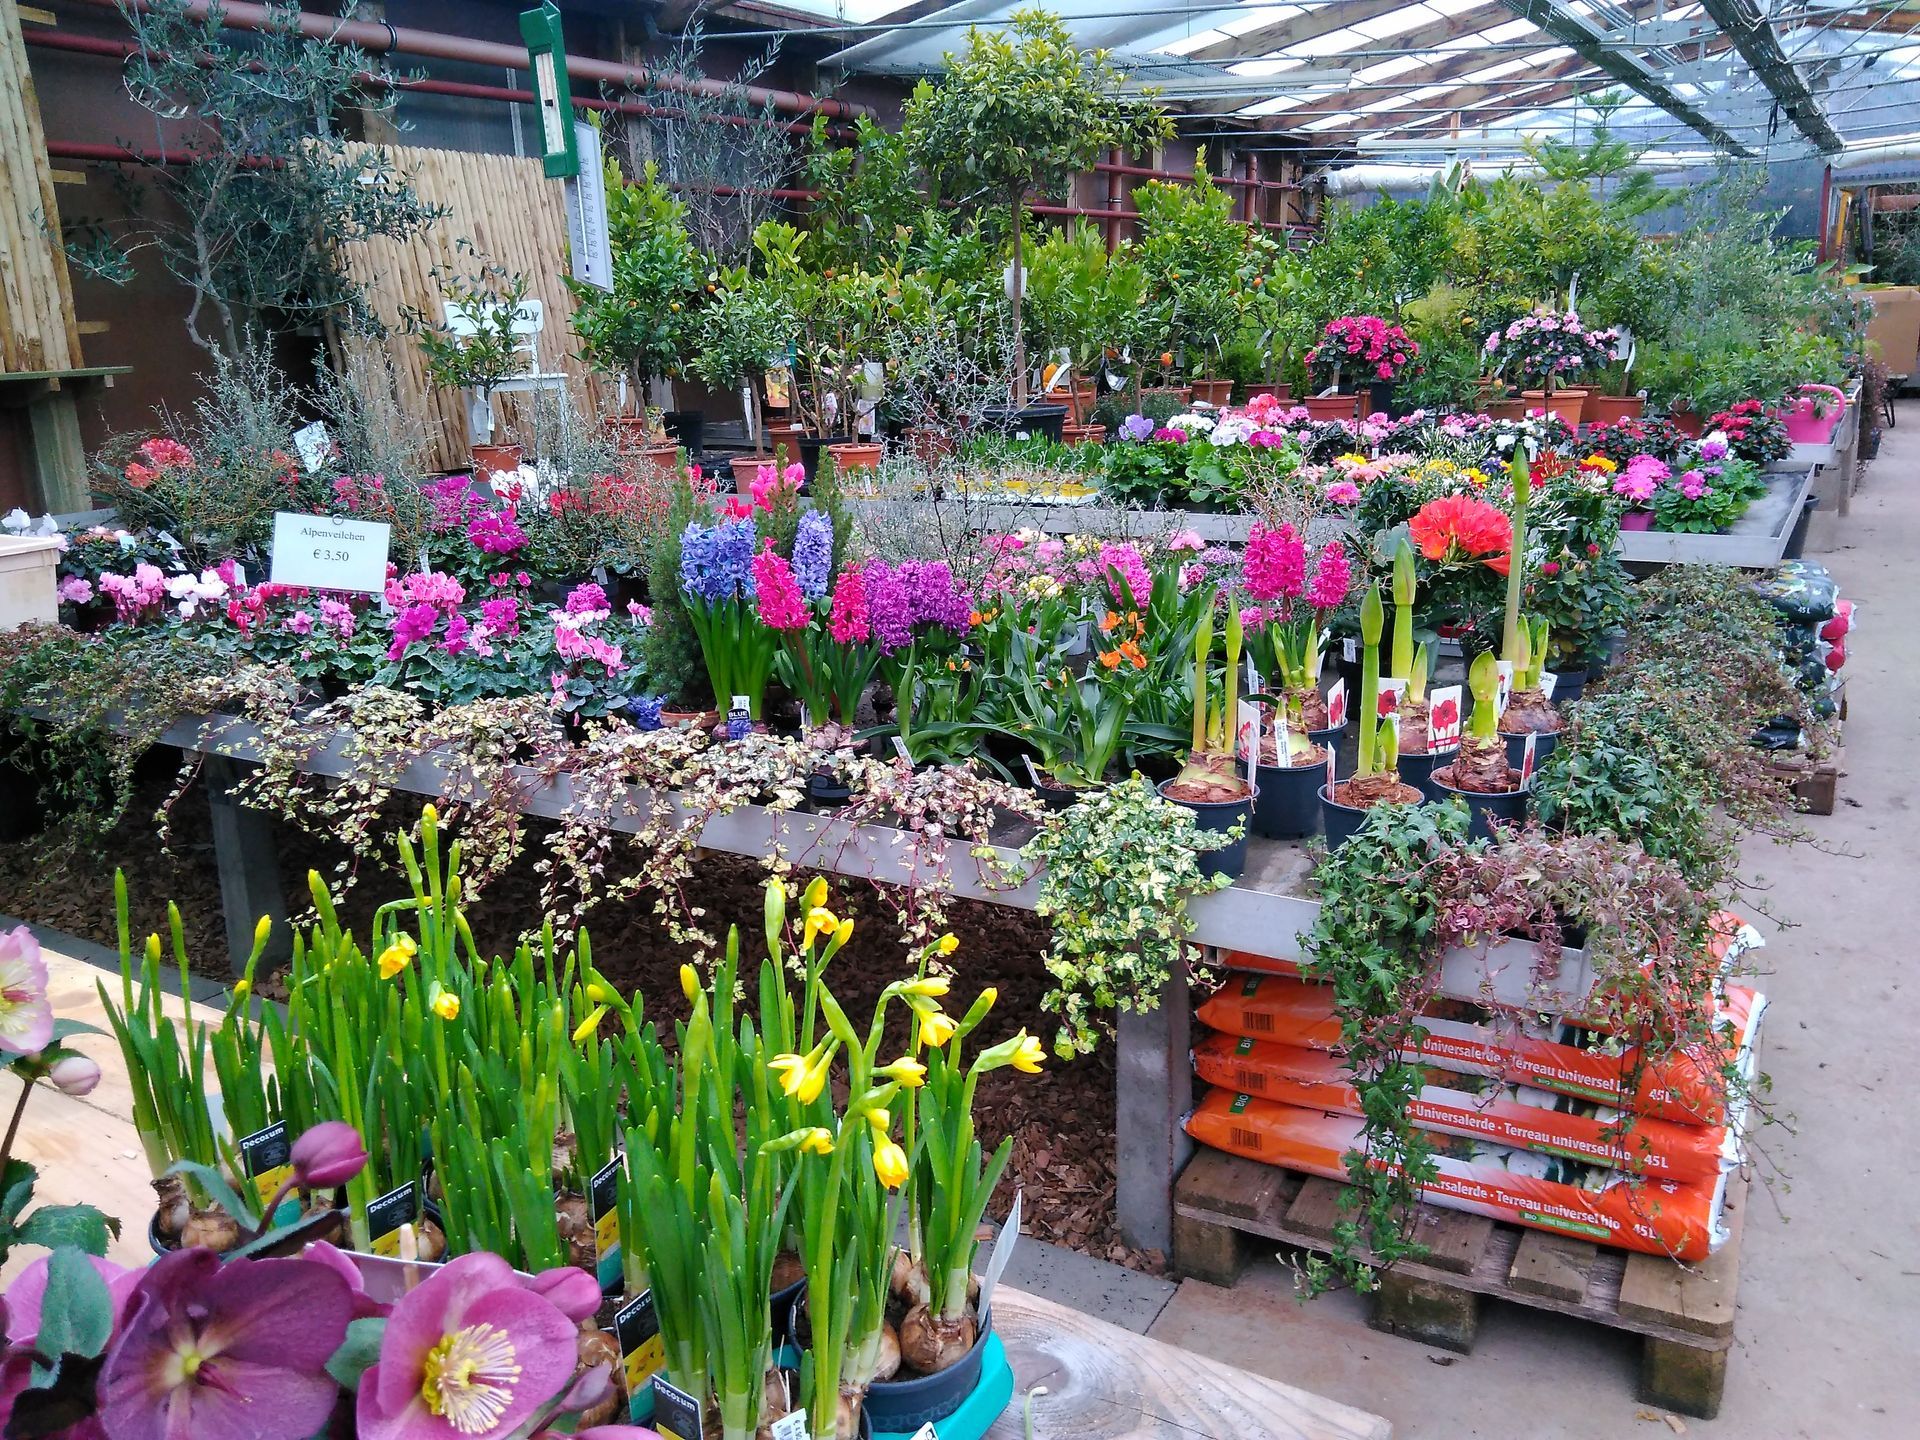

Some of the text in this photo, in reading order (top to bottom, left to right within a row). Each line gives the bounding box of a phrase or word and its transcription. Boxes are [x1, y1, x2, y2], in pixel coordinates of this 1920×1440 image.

[300, 527, 365, 542] Alpenveilchen
[313, 549, 321, 559] €
[1558, 1069, 1614, 1091] universel
[1235, 1094, 1249, 1107] BIO
[242, 1126, 284, 1150] Decorum
[1405, 1104, 1495, 1131] o-Universalerde
[1504, 1121, 1549, 1143] Terreau
[1552, 1135, 1609, 1156] universel
[370, 1187, 412, 1214] Decorum
[1495, 1190, 1541, 1210] Terreau
[1544, 1204, 1599, 1224] universel
[1601, 1214, 1621, 1230] bio
[619, 1296, 652, 1325] Decoru
[653, 1381, 696, 1412] Decorum
